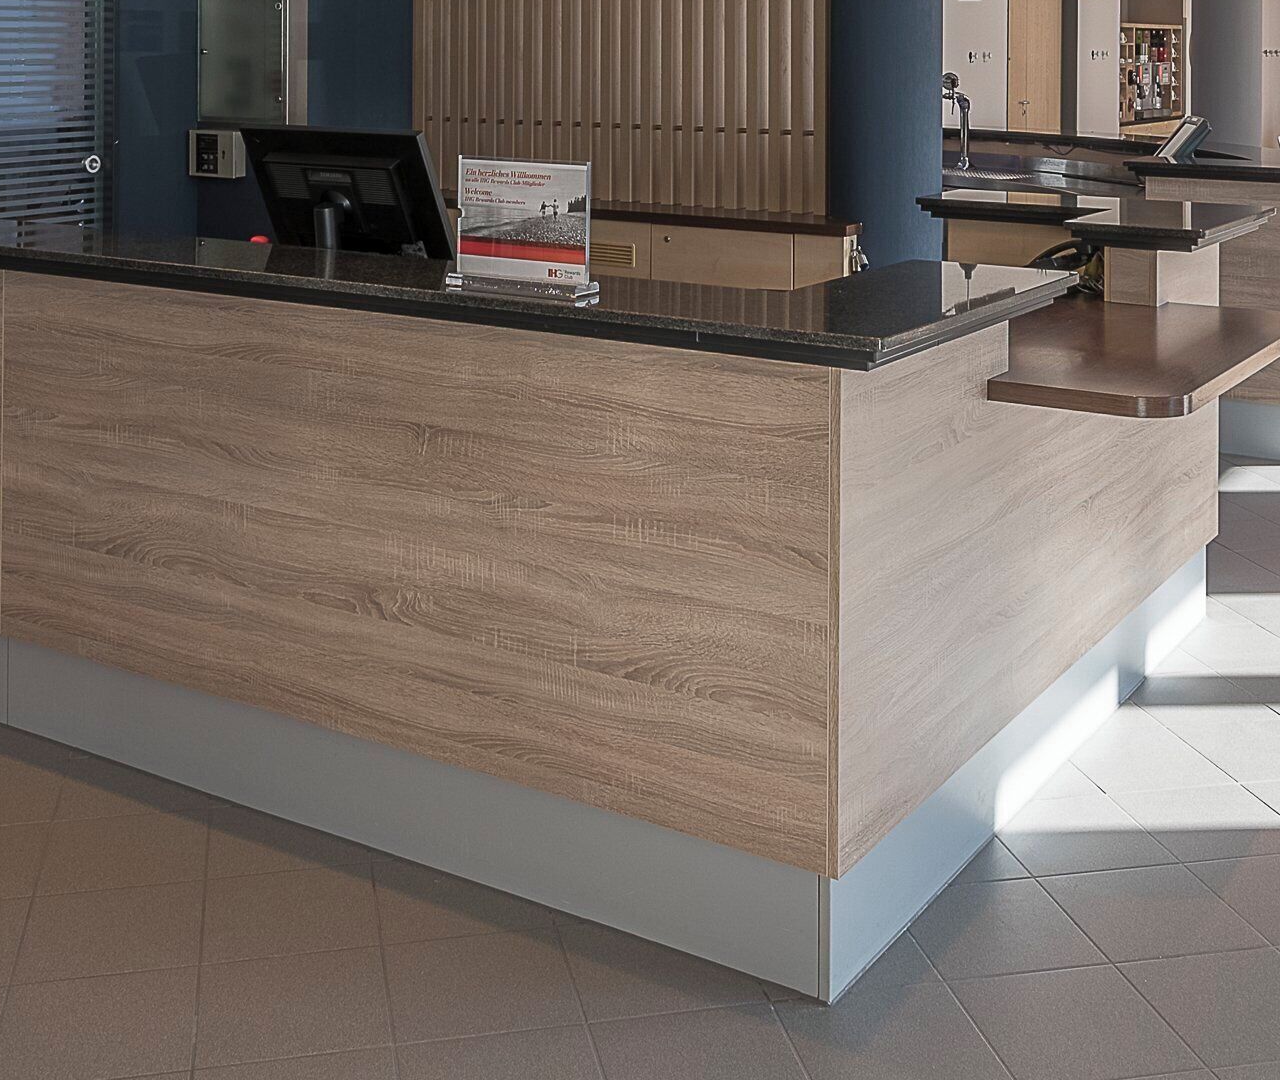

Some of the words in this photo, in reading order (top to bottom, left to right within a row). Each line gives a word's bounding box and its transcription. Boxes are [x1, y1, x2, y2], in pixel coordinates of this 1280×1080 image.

[465, 168, 477, 176] Ein
[478, 169, 510, 178] herzliches
[510, 171, 552, 180] Willkommen
[465, 188, 492, 196] Welcome
[548, 269, 563, 278] IHG
